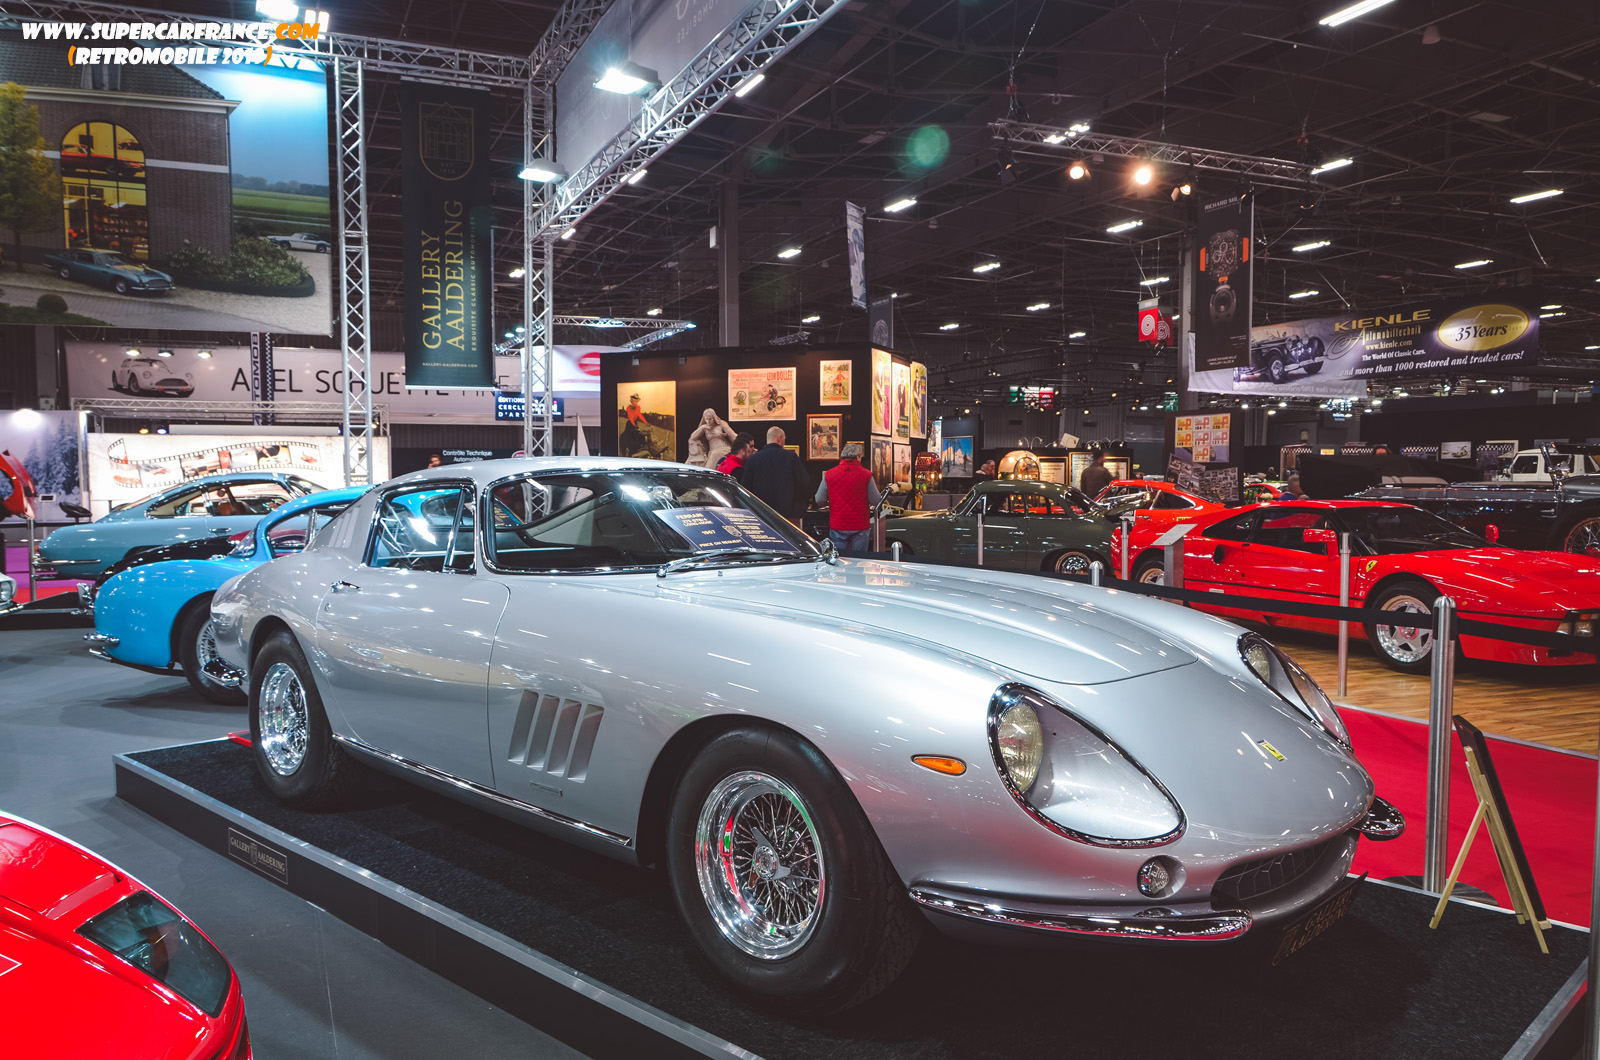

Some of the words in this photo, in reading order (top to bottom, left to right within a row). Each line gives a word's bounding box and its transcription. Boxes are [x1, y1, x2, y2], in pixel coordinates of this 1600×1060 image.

[1204, 200, 1228, 210] RICHARD
[444, 200, 465, 351] AALDERING
[421, 229, 442, 349] GALLERY
[1334, 309, 1432, 332] KIENLE
[1455, 326, 1471, 342] 35
[1471, 323, 1508, 338] Years
[1362, 354, 1371, 362] The
[1371, 352, 1387, 361] World
[1387, 351, 1394, 359] Of
[1394, 350, 1412, 358] Classic
[1365, 339, 1413, 350] www.kienle.com
[1355, 366, 1374, 375] more
[1375, 363, 1393, 374] than
[1394, 361, 1414, 371] 1000
[1415, 357, 1449, 369] restored
[1451, 355, 1468, 366] and
[1469, 352, 1499, 364] traded
[1501, 350, 1525, 361] cars!
[231, 367, 303, 392] AEL
[230, 836, 250, 854] GALLERY
[257, 851, 286, 872] AALDERING
